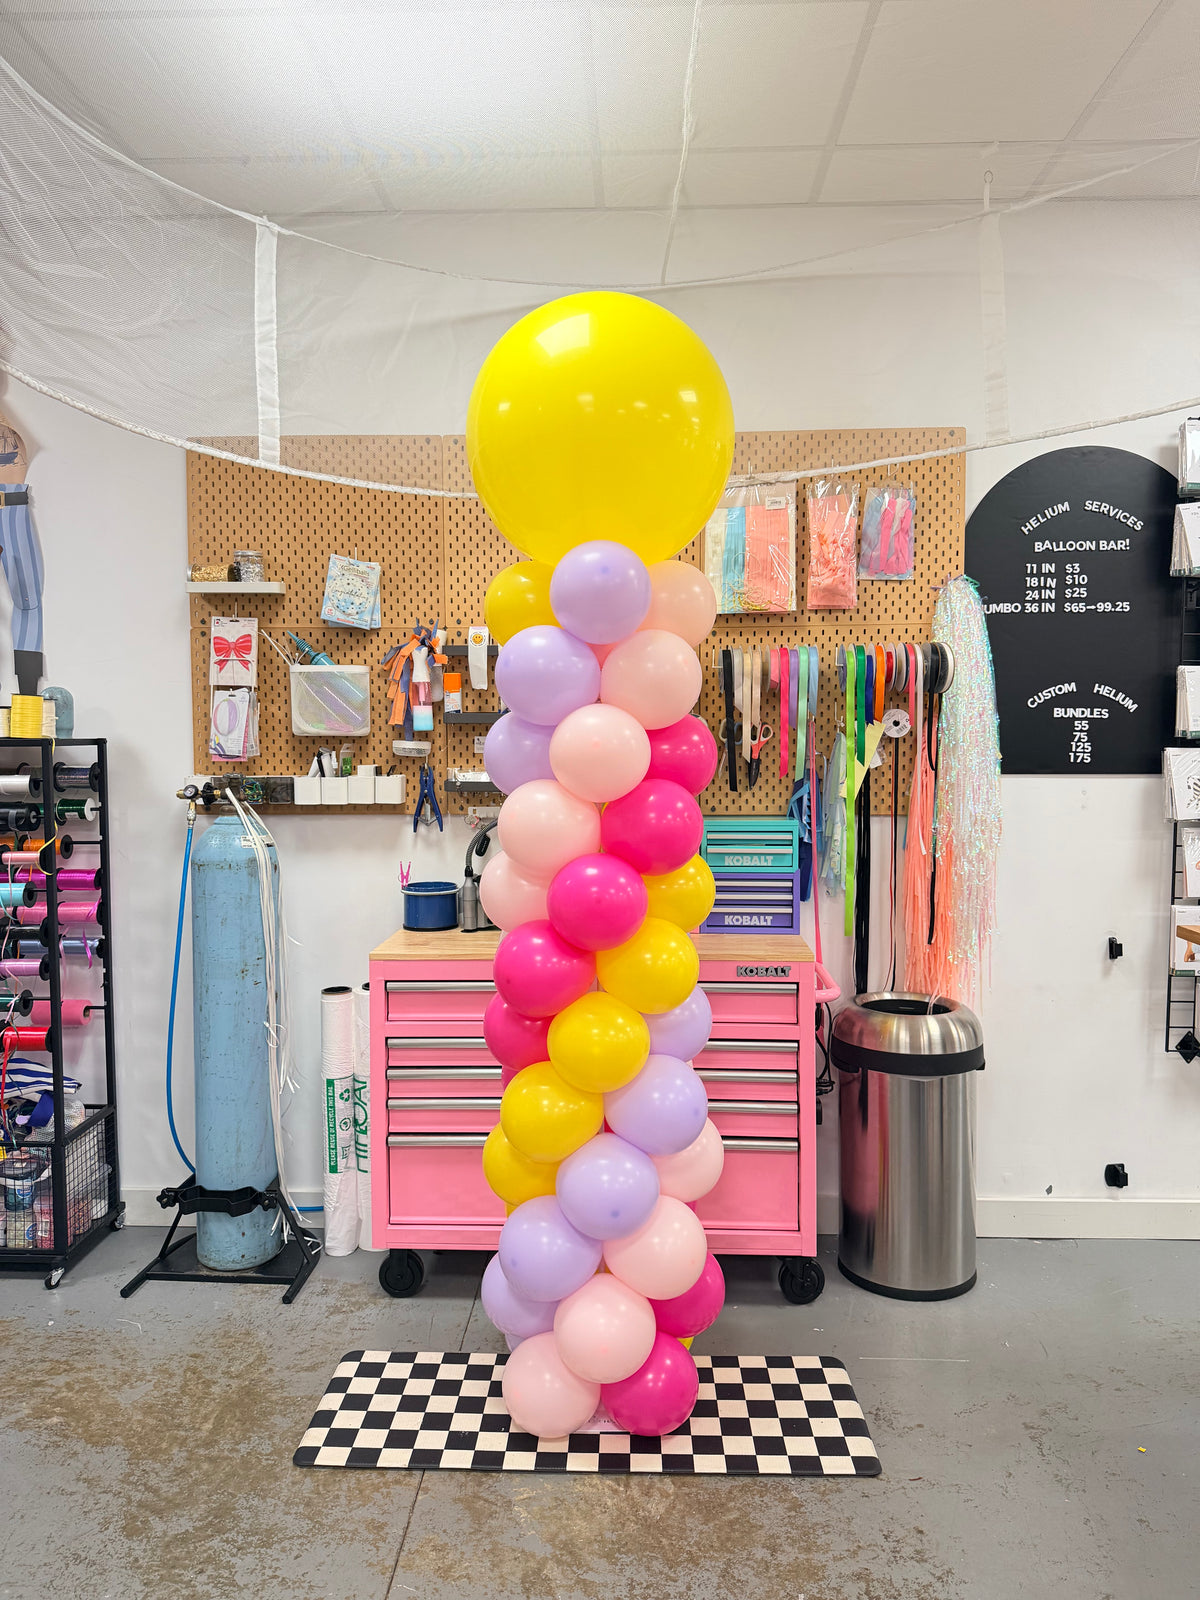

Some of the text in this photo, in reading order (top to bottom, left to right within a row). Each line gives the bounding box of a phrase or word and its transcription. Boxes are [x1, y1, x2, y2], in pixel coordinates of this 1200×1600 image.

[1021, 500, 1144, 535] HELIUM SERVICES
[1034, 538, 1130, 552] BALLOON BAR!
[1025, 563, 1081, 574] 11 IN $3
[1025, 574, 1088, 589] 18 IN $10
[1025, 587, 1088, 601] 24 IN $25
[982, 602, 1021, 614] UMBO
[1024, 602, 1039, 613] 36
[1041, 602, 1055, 613] IN
[1027, 682, 1139, 713] CUSTOM HELIUM
[1053, 707, 1109, 719] BUNDLES
[1073, 720, 1089, 731] 55
[1072, 732, 1088, 742] 75
[1070, 742, 1092, 752] 125
[1068, 752, 1091, 763] 175
[724, 855, 773, 866] KOBALT
[724, 915, 773, 926] KOBALT
[736, 966, 791, 977] KOBALT
